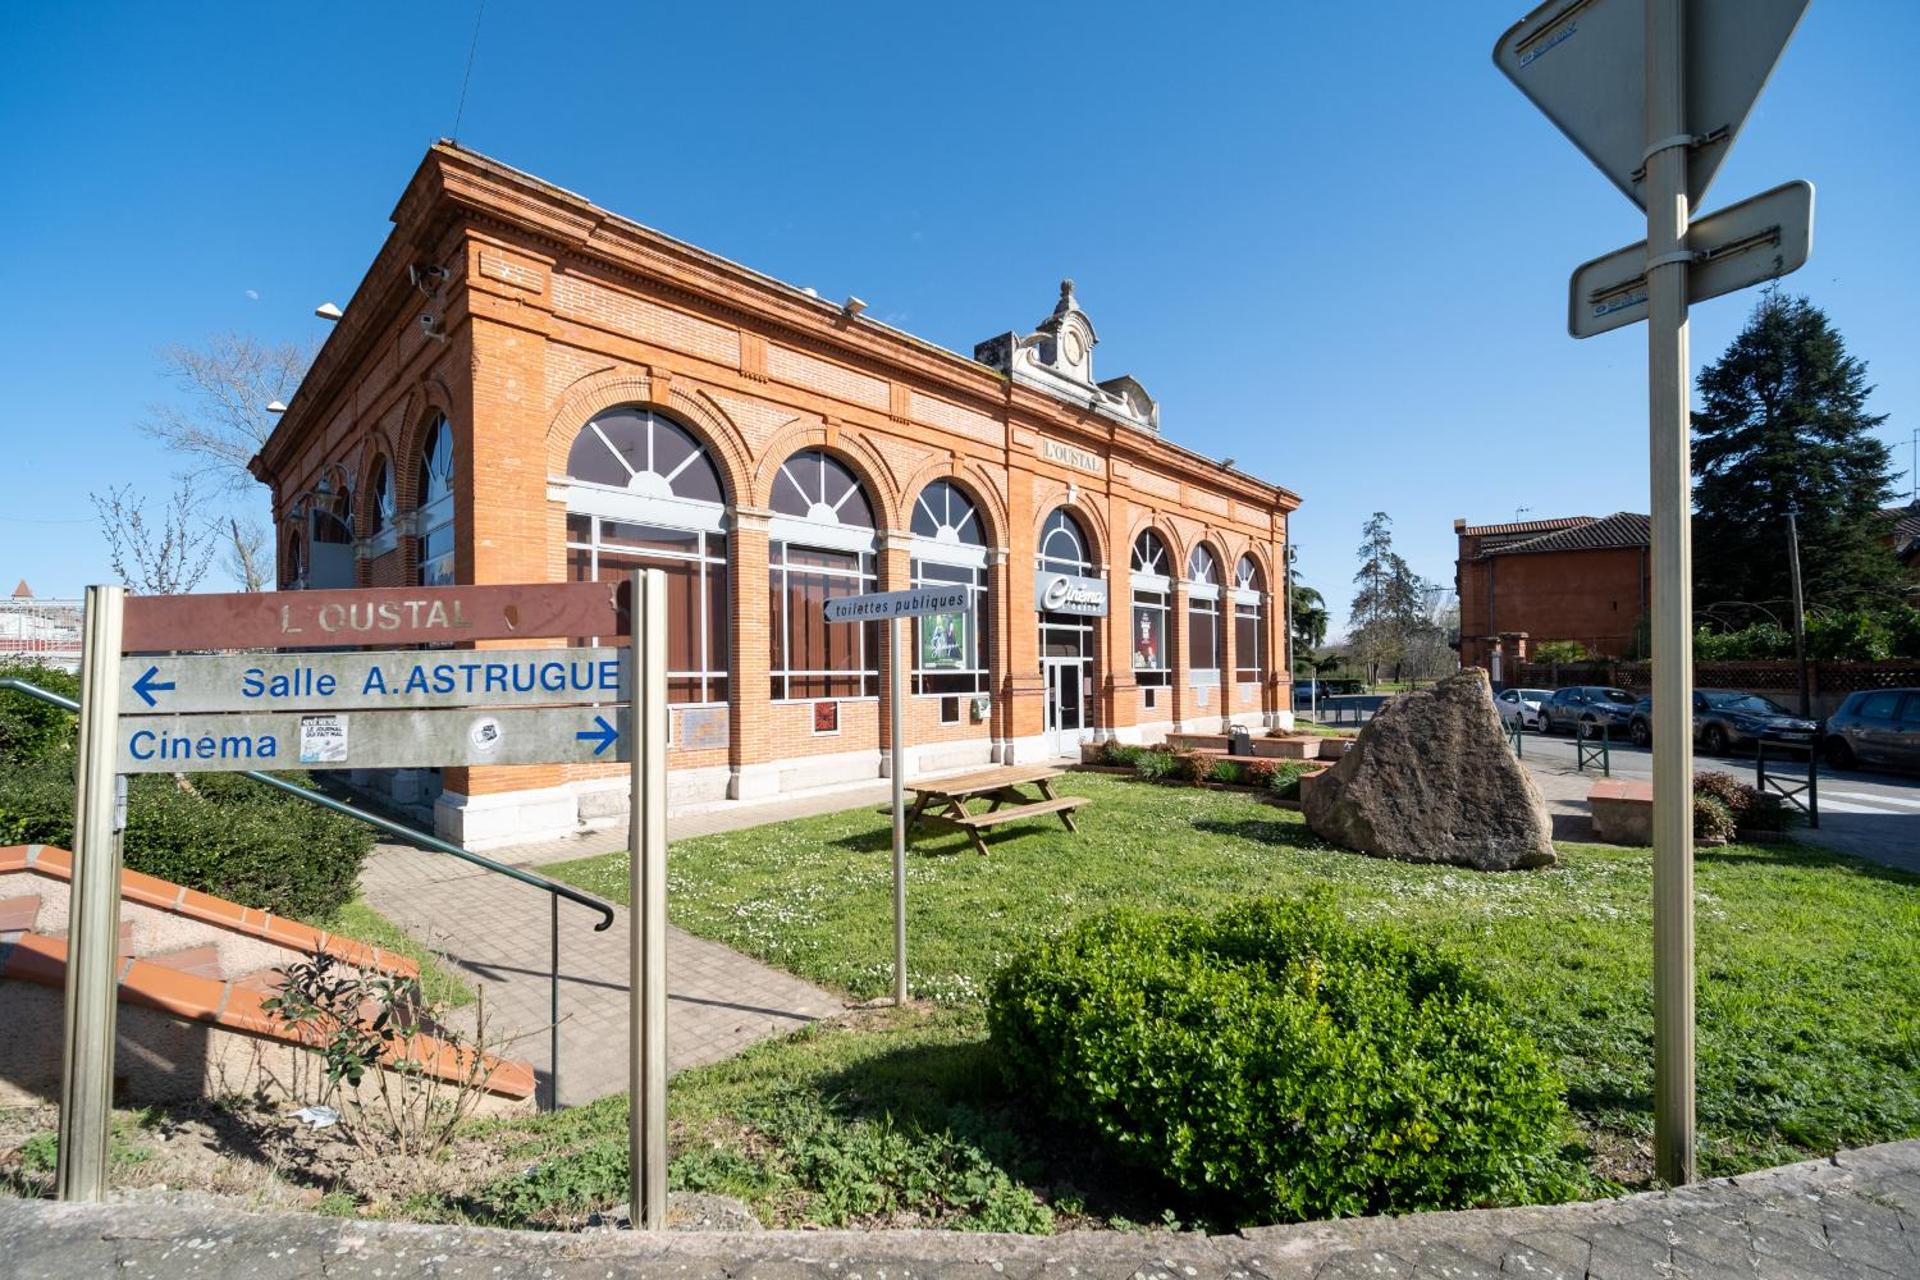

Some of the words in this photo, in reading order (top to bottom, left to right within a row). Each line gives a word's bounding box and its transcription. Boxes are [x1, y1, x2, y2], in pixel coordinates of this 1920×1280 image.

[1045, 441, 1100, 472] L'OUSTAL
[836, 601, 888, 617] toilettes
[895, 594, 964, 615] publiques
[242, 668, 336, 698] Salle
[362, 661, 620, 695] A.ASTRUGUE
